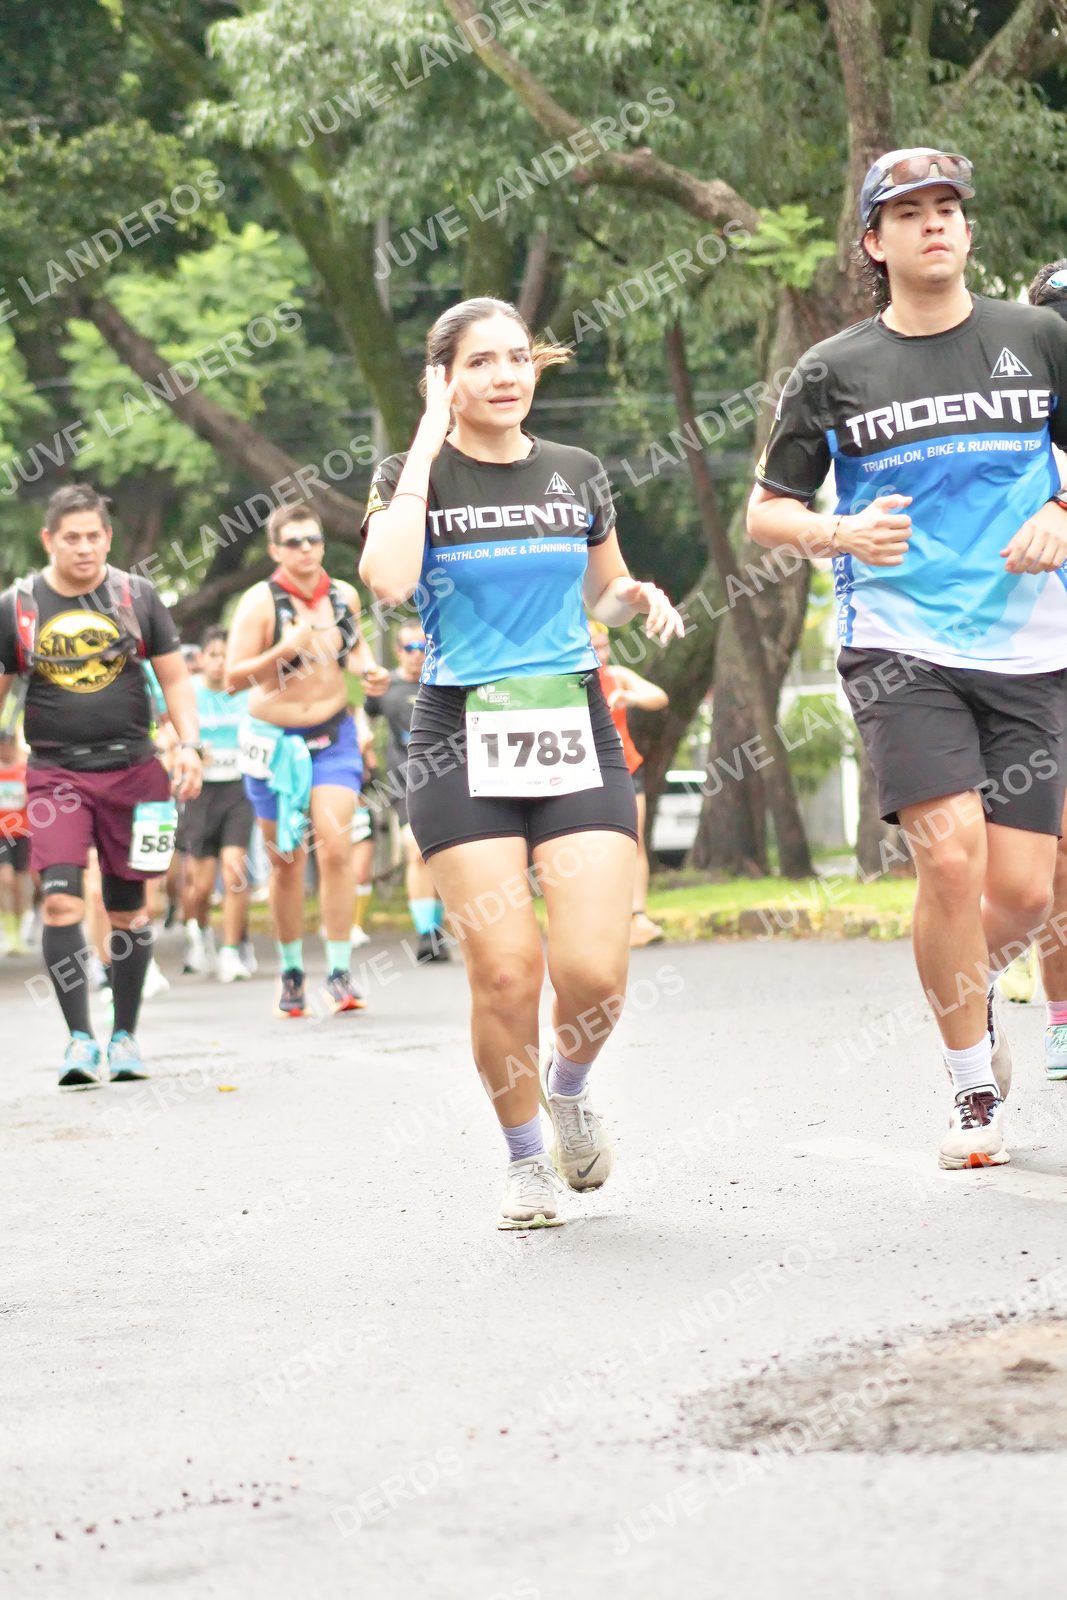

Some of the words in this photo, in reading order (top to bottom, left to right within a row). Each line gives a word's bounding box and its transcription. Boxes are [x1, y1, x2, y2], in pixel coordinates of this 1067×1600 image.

[846, 390, 1051, 448] TRIDENTE
[862, 450, 925, 473] TRIATHLON,
[927, 443, 954, 458] BIKE
[957, 441, 965, 452] &
[968, 440, 1021, 452] RUNNING
[429, 502, 589, 536] TRIDENTE
[436, 549, 491, 562] TRIATHLON,
[494, 546, 517, 557] BIKE
[520, 545, 527, 555] &
[529, 543, 571, 554] RUNNING
[481, 729, 586, 768] 1783
[140, 834, 176, 853] 58
